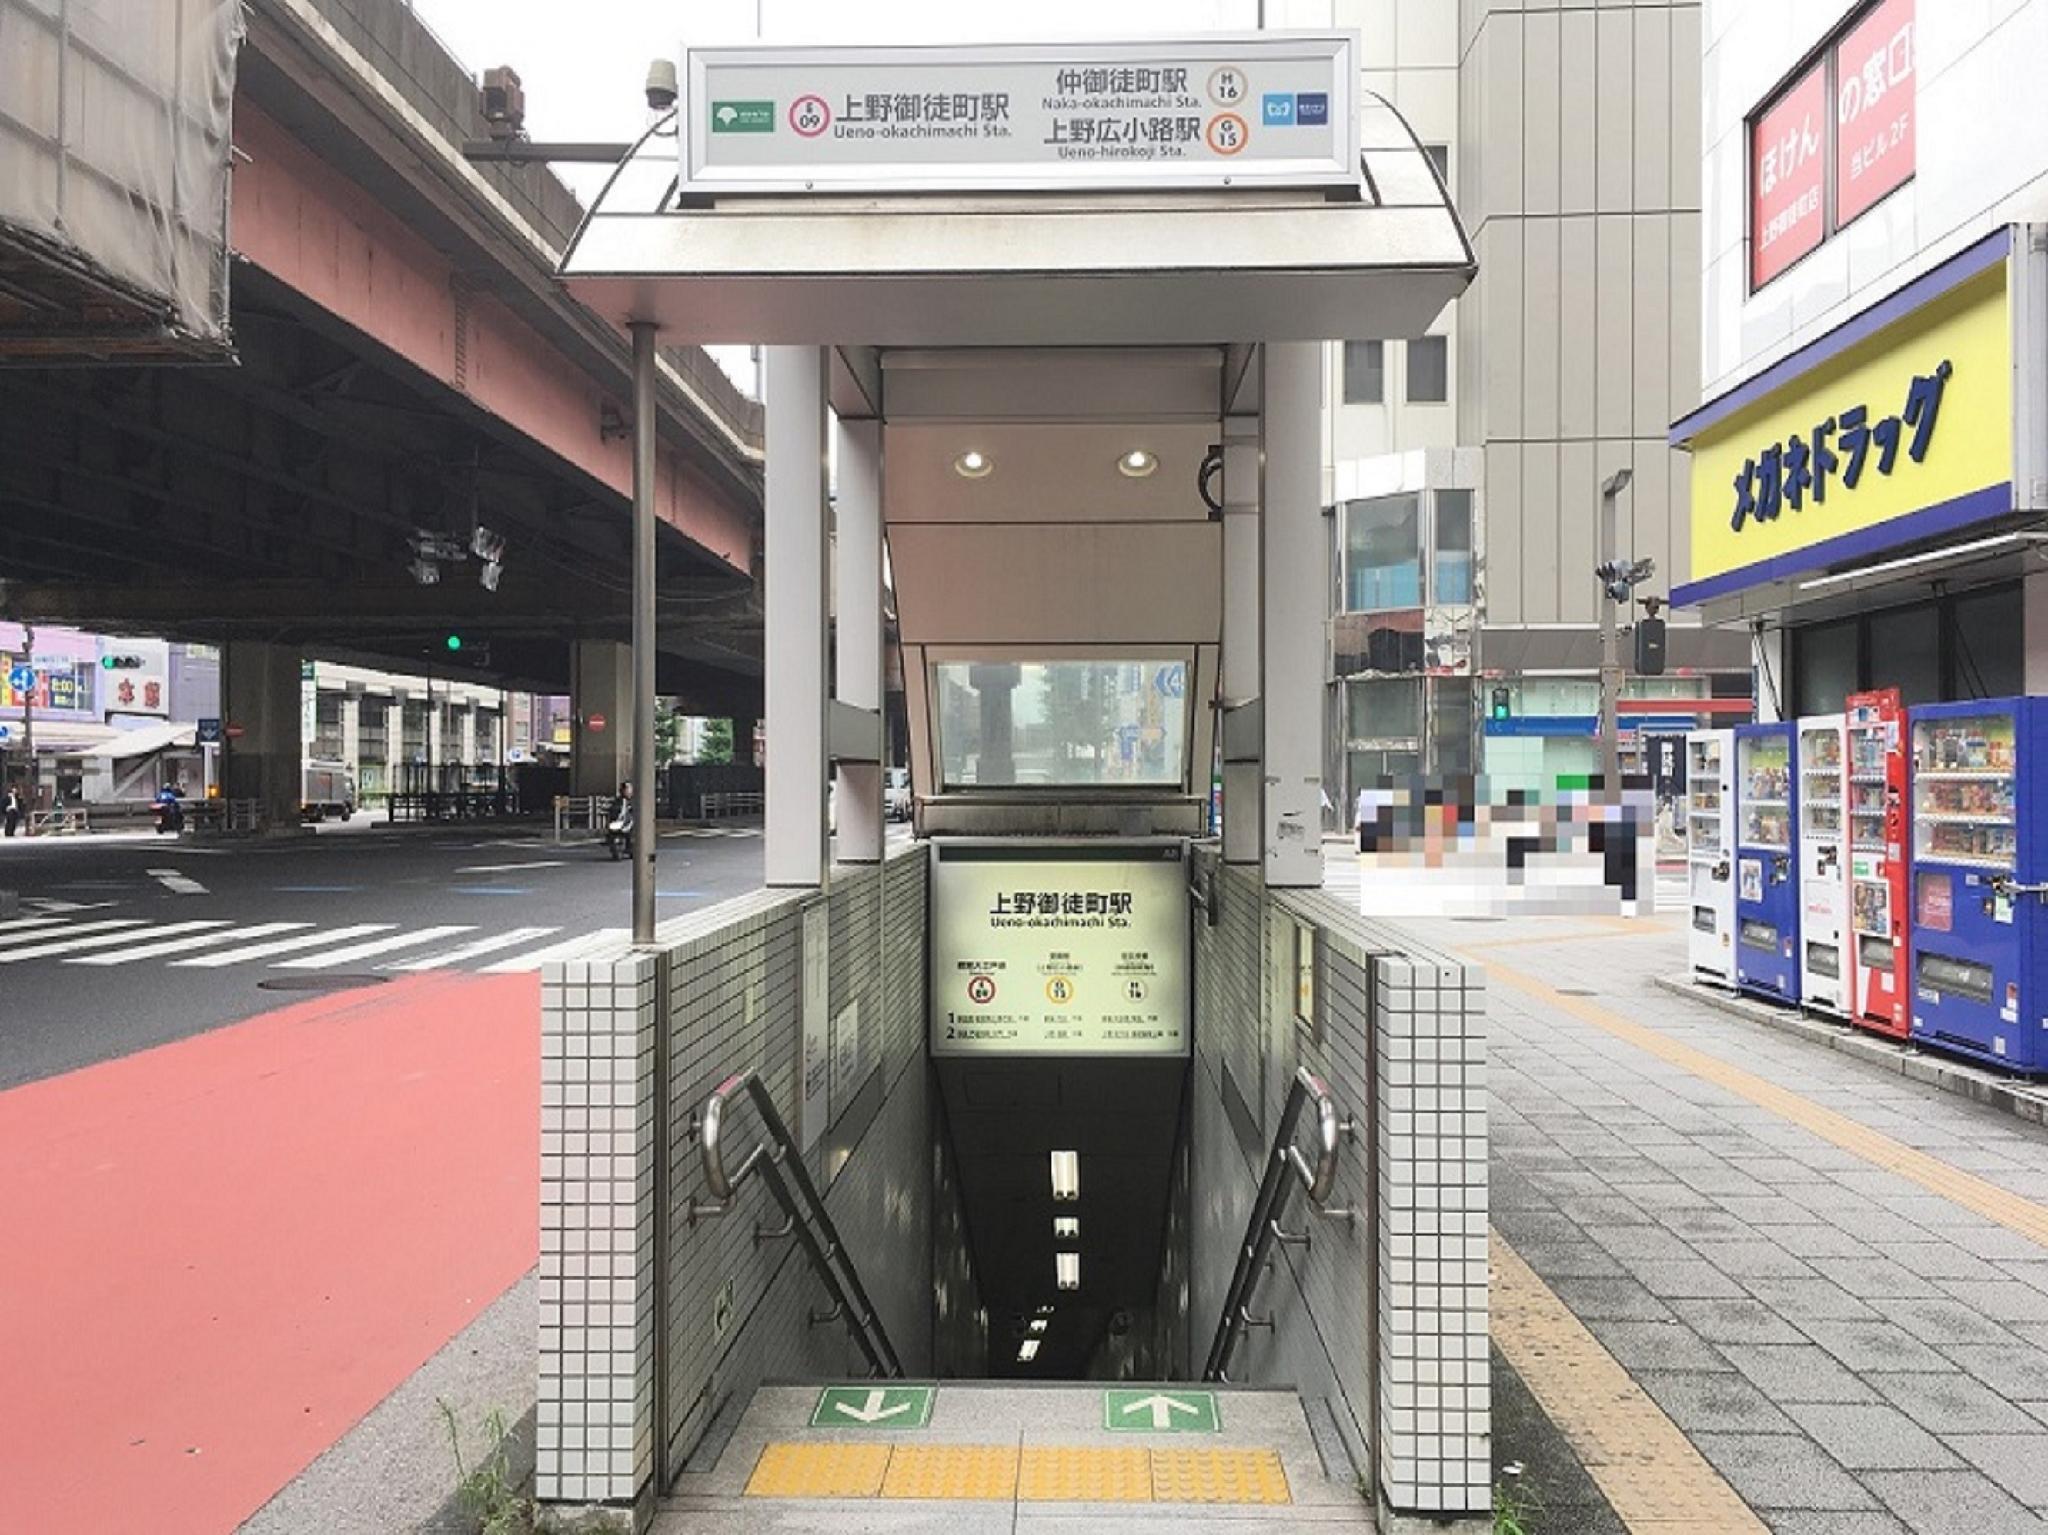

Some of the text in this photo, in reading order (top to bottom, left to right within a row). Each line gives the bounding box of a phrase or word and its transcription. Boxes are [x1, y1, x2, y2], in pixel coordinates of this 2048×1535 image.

[1056, 68, 1187, 95] 仲御徒町駅
[1219, 85, 1238, 98] 16
[834, 93, 1010, 122] 上野御徒町駅
[1041, 97, 1202, 109] Naka-okachimachi Sta.
[1760, 22, 1913, 199] ほけん の窓口
[800, 114, 820, 128] 09
[834, 124, 1012, 139] Ueno-okachimachi Sta.
[1043, 117, 1201, 144] 上野広小路駅
[1890, 113, 1910, 145] 2F
[1219, 132, 1236, 146] 15
[1159, 145, 1187, 158] Sta.
[1731, 359, 1953, 533] メガネドラッグ
[989, 891, 1133, 915] 上野御徒町駅
[990, 915, 1133, 929] Ueno-okachimachi Sta.
[946, 1026, 955, 1039] 2
